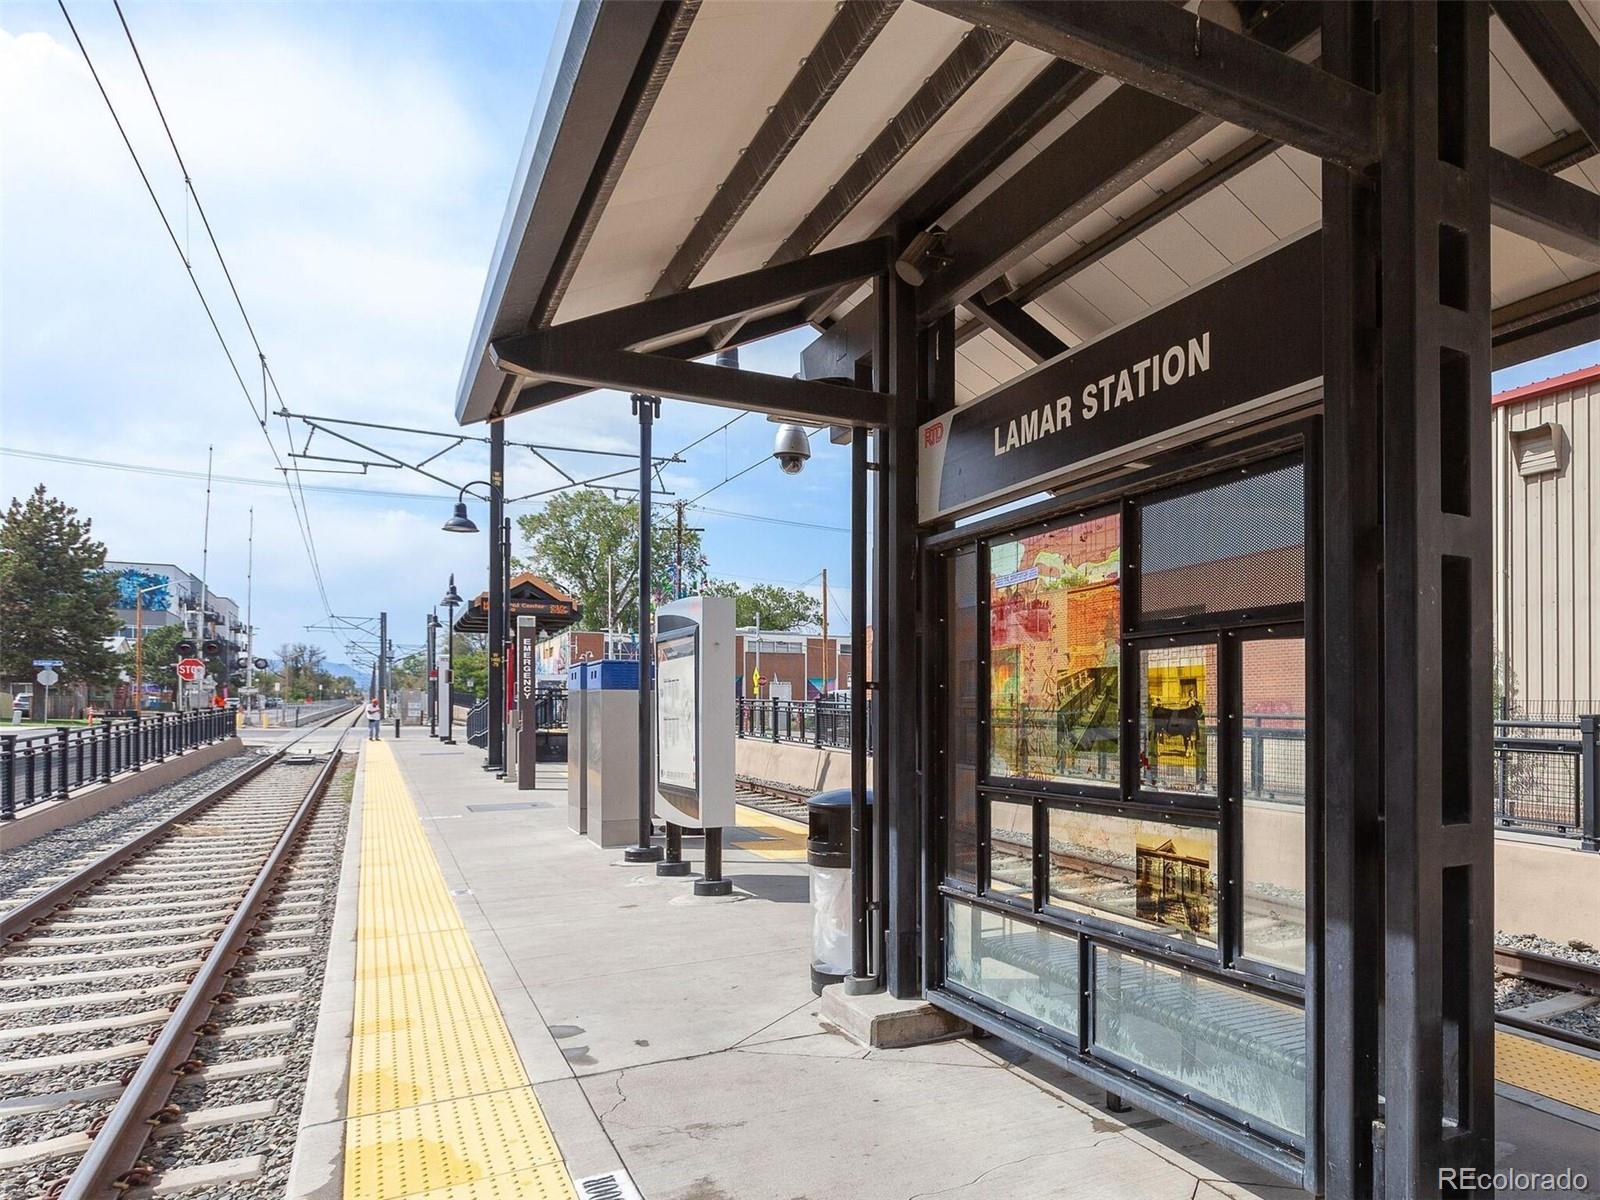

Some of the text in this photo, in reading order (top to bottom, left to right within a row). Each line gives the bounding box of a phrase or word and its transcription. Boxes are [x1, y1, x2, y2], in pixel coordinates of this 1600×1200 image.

[994, 331, 1210, 456] LAMAR STATION
[924, 422, 944, 449] RTD
[523, 638, 532, 700] EMERGENCY
[582, 1175, 625, 1200] OOR
